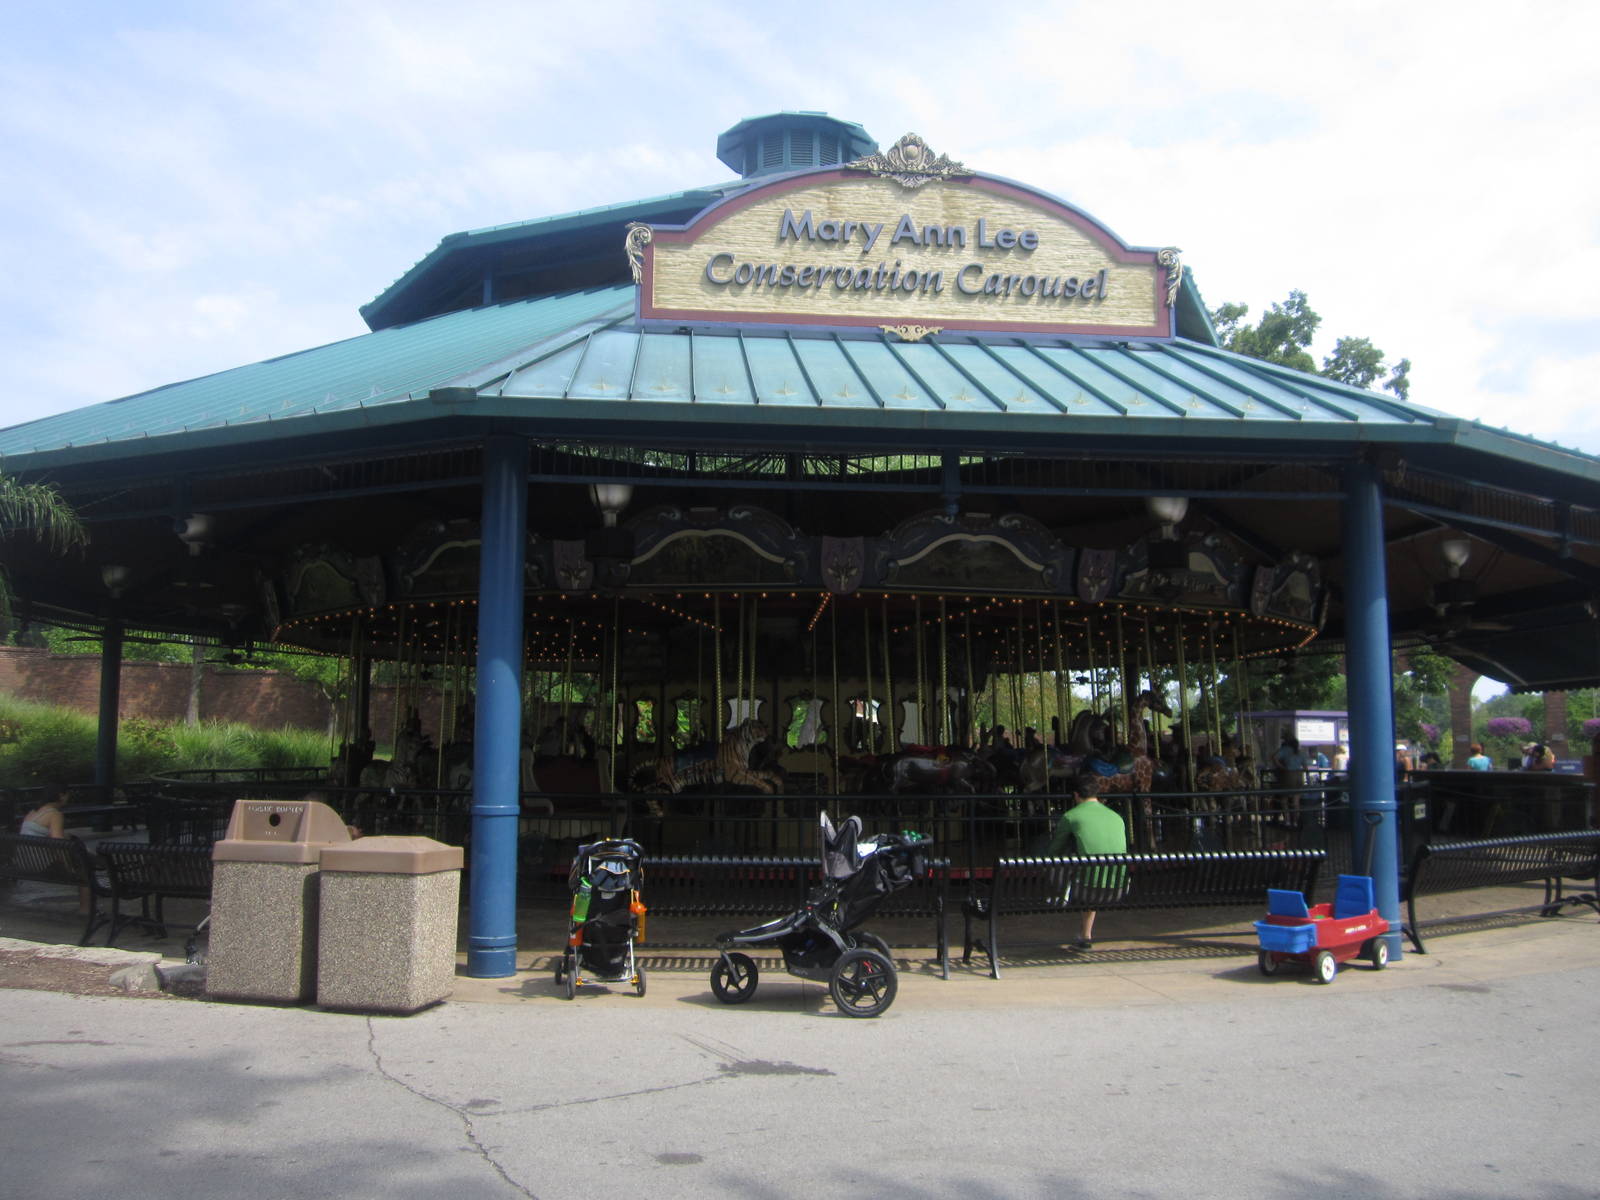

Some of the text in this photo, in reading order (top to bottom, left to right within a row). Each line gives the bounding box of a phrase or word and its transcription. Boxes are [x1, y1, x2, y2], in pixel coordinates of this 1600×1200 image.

[779, 208, 1039, 254] Mary Ann Lee
[705, 252, 1109, 299] Conservation Carousel
